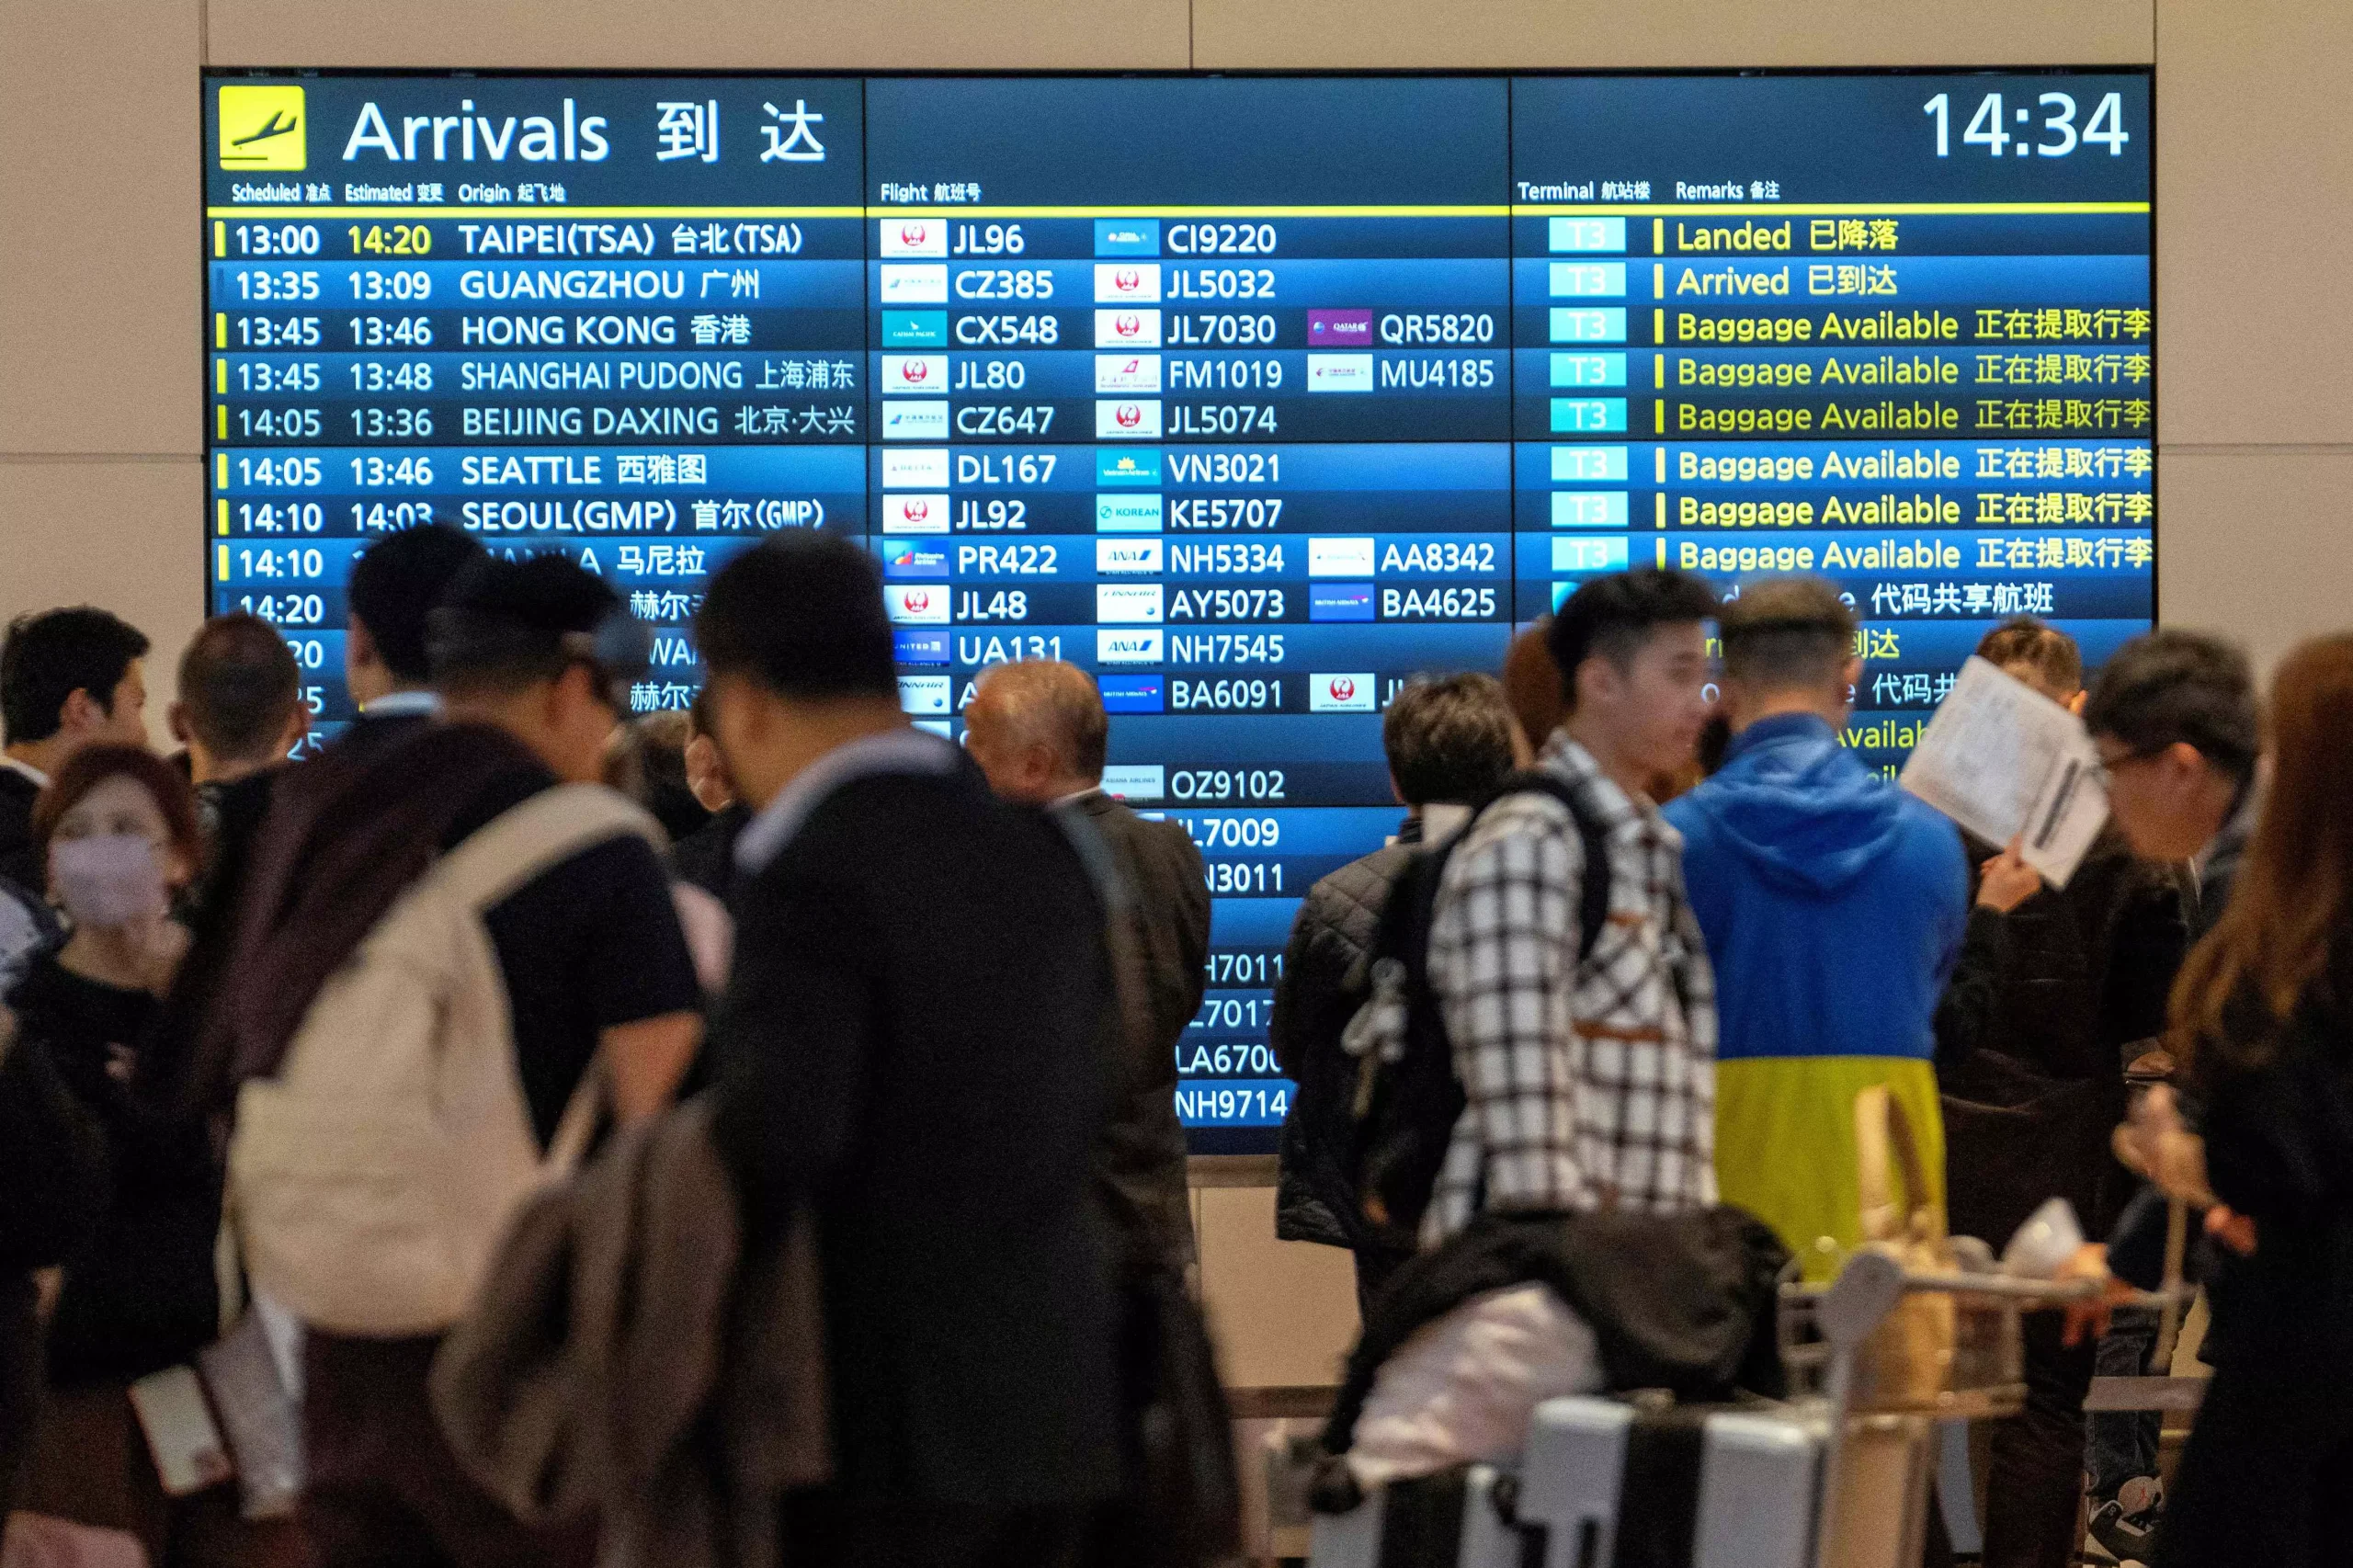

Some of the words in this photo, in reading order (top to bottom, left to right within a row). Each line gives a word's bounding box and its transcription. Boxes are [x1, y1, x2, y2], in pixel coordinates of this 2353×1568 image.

[343, 98, 608, 160] Arrivals
[1924, 93, 2128, 155] 14:34
[233, 183, 300, 201] Scheduled
[306, 183, 330, 201] 准点
[346, 183, 412, 201] Estimated
[417, 183, 442, 201] 变更
[459, 184, 509, 202] Origin
[517, 184, 564, 201] 起飞地
[881, 183, 927, 202] Flight
[934, 183, 980, 201] 航班号
[1518, 181, 1593, 199] Terminal
[1602, 181, 1650, 199] 航站楼
[1677, 181, 1744, 199] Remarks
[1750, 181, 1779, 199] 备注
[236, 225, 319, 254] 13:00
[348, 225, 430, 254] 14:20
[459, 223, 654, 255] TAIPEI(TSA)
[672, 223, 801, 253] 台北(TSA)
[954, 225, 1024, 253] JL96
[1168, 224, 1276, 253] CI9220
[1568, 222, 1605, 248] T3
[1678, 221, 1790, 250] Landed
[1811, 219, 1898, 250] 已降落
[237, 271, 319, 300] 13:35
[349, 271, 430, 299] 13:09
[460, 270, 684, 299] GUANGZHOU
[700, 269, 758, 298] 广州
[956, 270, 1052, 298] CZ385
[1167, 269, 1275, 298] JL5032
[1568, 267, 1605, 293] T3
[1677, 266, 1789, 295] Arrived
[1809, 265, 1897, 295] 已到达
[238, 317, 318, 345] 13:45
[350, 317, 430, 345] 13:46
[462, 316, 563, 344] HONG
[576, 316, 674, 344] KONG
[691, 314, 750, 344] 香港
[956, 316, 1057, 344] CX548
[1168, 315, 1275, 343] JL7030
[1381, 314, 1493, 344] QR5820
[1568, 312, 1606, 338] T3
[1678, 313, 1812, 342] Baggage
[1820, 311, 1958, 339] Available
[1974, 308, 2150, 338] 正在提取行李
[239, 363, 319, 391] 13:45
[351, 363, 431, 390] 13:48
[461, 362, 608, 390] SHANGHAI
[620, 361, 741, 389] PUDONG
[756, 359, 854, 389] 上海浦东
[956, 361, 1025, 389] JL80
[1170, 360, 1281, 388] FM1019
[1381, 359, 1494, 387] MU4185
[1568, 357, 1606, 383] T3
[1679, 358, 1812, 386] Baggage
[1821, 356, 1958, 383] Available
[1975, 353, 2150, 383] 正在提取行李
[239, 409, 319, 437] 14:05
[351, 409, 431, 436] 13:36
[463, 408, 581, 435] BEIJING
[594, 407, 717, 435] DAXING
[957, 406, 1053, 434] CZ647
[1169, 406, 1277, 433] JL5074
[1569, 402, 1606, 429] T3
[1679, 404, 1812, 432] Baggage
[1821, 401, 1959, 428] Available
[1975, 398, 2150, 428] 正在提取行李
[239, 458, 321, 485] 14:05
[351, 457, 433, 485] 13:46
[462, 456, 600, 484] SEATTLE
[617, 454, 706, 483] 西雅图
[959, 455, 1056, 483] DL167
[1169, 454, 1278, 482] VN3021
[1570, 450, 1607, 477] T3
[1679, 452, 1813, 481] Baggage
[1822, 449, 1960, 478] Available
[1976, 447, 2152, 478] 正在提取行李
[240, 504, 322, 531] 14:10
[462, 500, 676, 531] SEOUL(GMP)
[956, 500, 1025, 528] JL92
[1116, 508, 1159, 517] KOREAN
[1171, 499, 1281, 527] KE5707
[1570, 495, 1608, 522] T3
[1680, 497, 1813, 526] Baggage
[1822, 494, 1960, 523] Available
[1976, 492, 2152, 523] 正在提取行李
[240, 549, 323, 576] 14:10
[618, 545, 705, 574] 马尼拉
[960, 545, 1057, 574] PR422
[1108, 551, 1137, 561] ANA
[1172, 544, 1284, 573] NH5334
[1381, 543, 1494, 571] AA8342
[1570, 540, 1608, 567] T3
[1680, 542, 1813, 571] Baggage
[1822, 540, 1961, 569] Available
[1976, 537, 2152, 568] 正在提取行李
[241, 595, 322, 622] 14:20
[957, 591, 1026, 619] JL48
[1170, 590, 1283, 617] AY5073
[1383, 588, 1495, 616] BA4625
[1871, 582, 2052, 614] 代码共享航班
[959, 636, 1062, 665] UA131
[1108, 642, 1137, 652] ANA
[1172, 635, 1283, 662] NH7545
[630, 681, 701, 711] 赫尔
[1173, 680, 1279, 708] BA6091
[1172, 771, 1284, 799] OZ9102
[1204, 863, 1283, 892] N3011
[1176, 1090, 1287, 1118] NH9714
